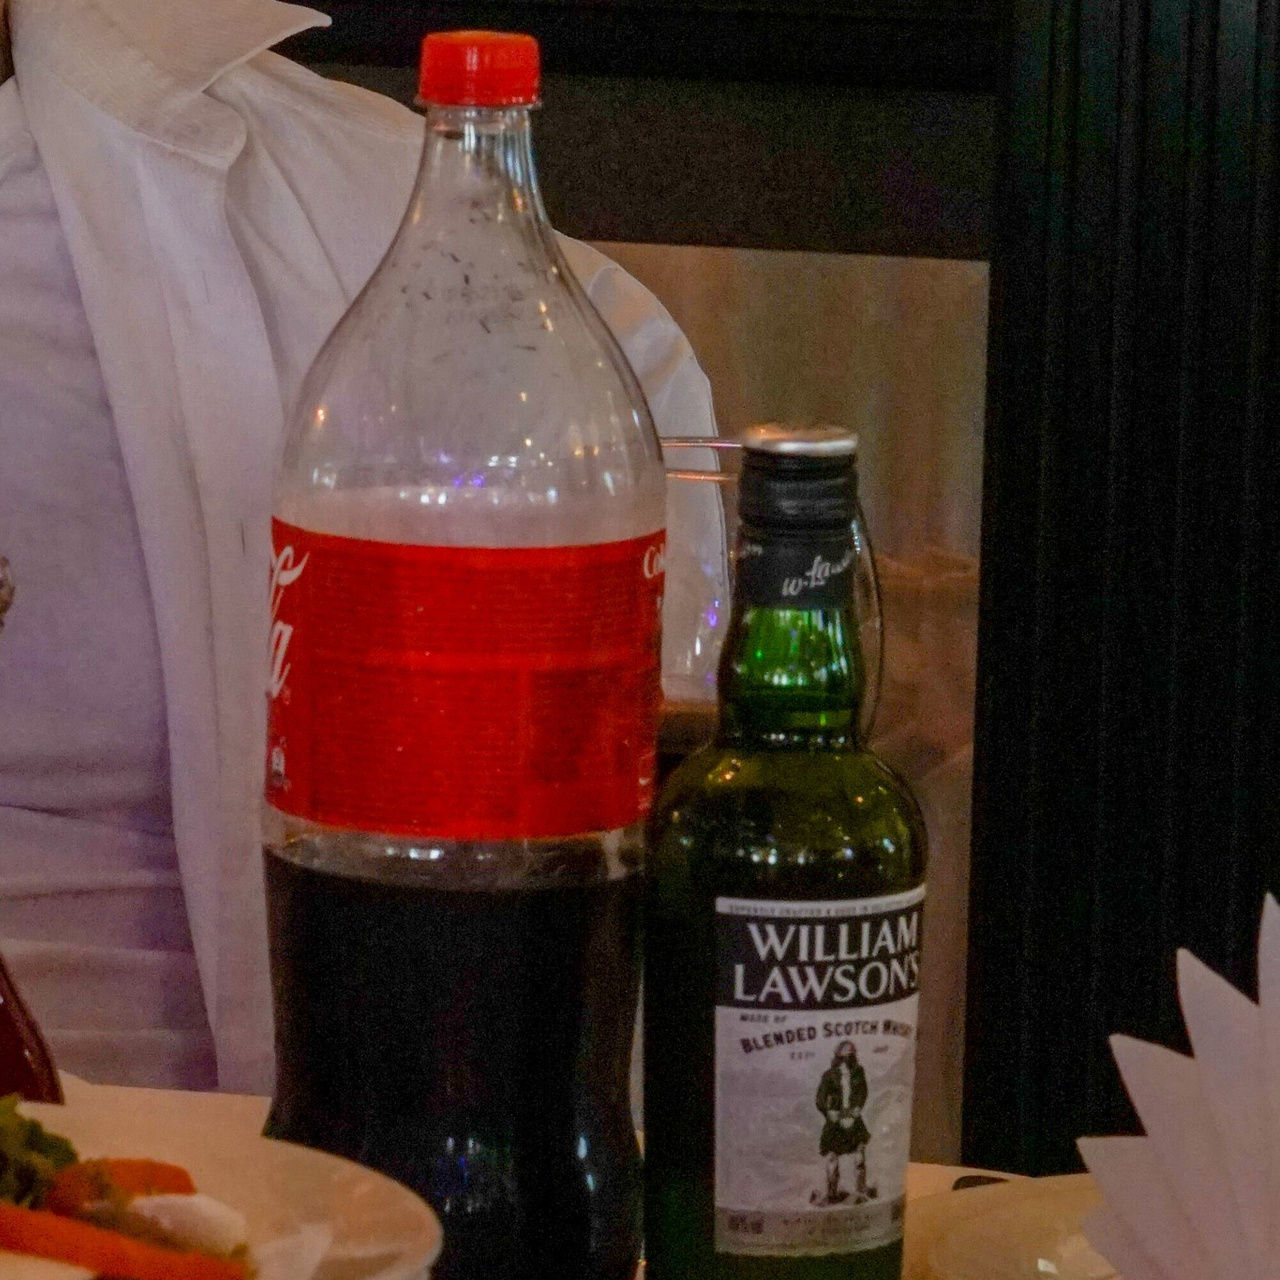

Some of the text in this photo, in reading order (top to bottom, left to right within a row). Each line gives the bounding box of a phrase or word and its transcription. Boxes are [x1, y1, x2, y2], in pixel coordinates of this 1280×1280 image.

[747, 911, 918, 961] WILLIAM
[739, 1026, 817, 1054] BLENDED
[823, 1020, 878, 1038] SCOTCH
